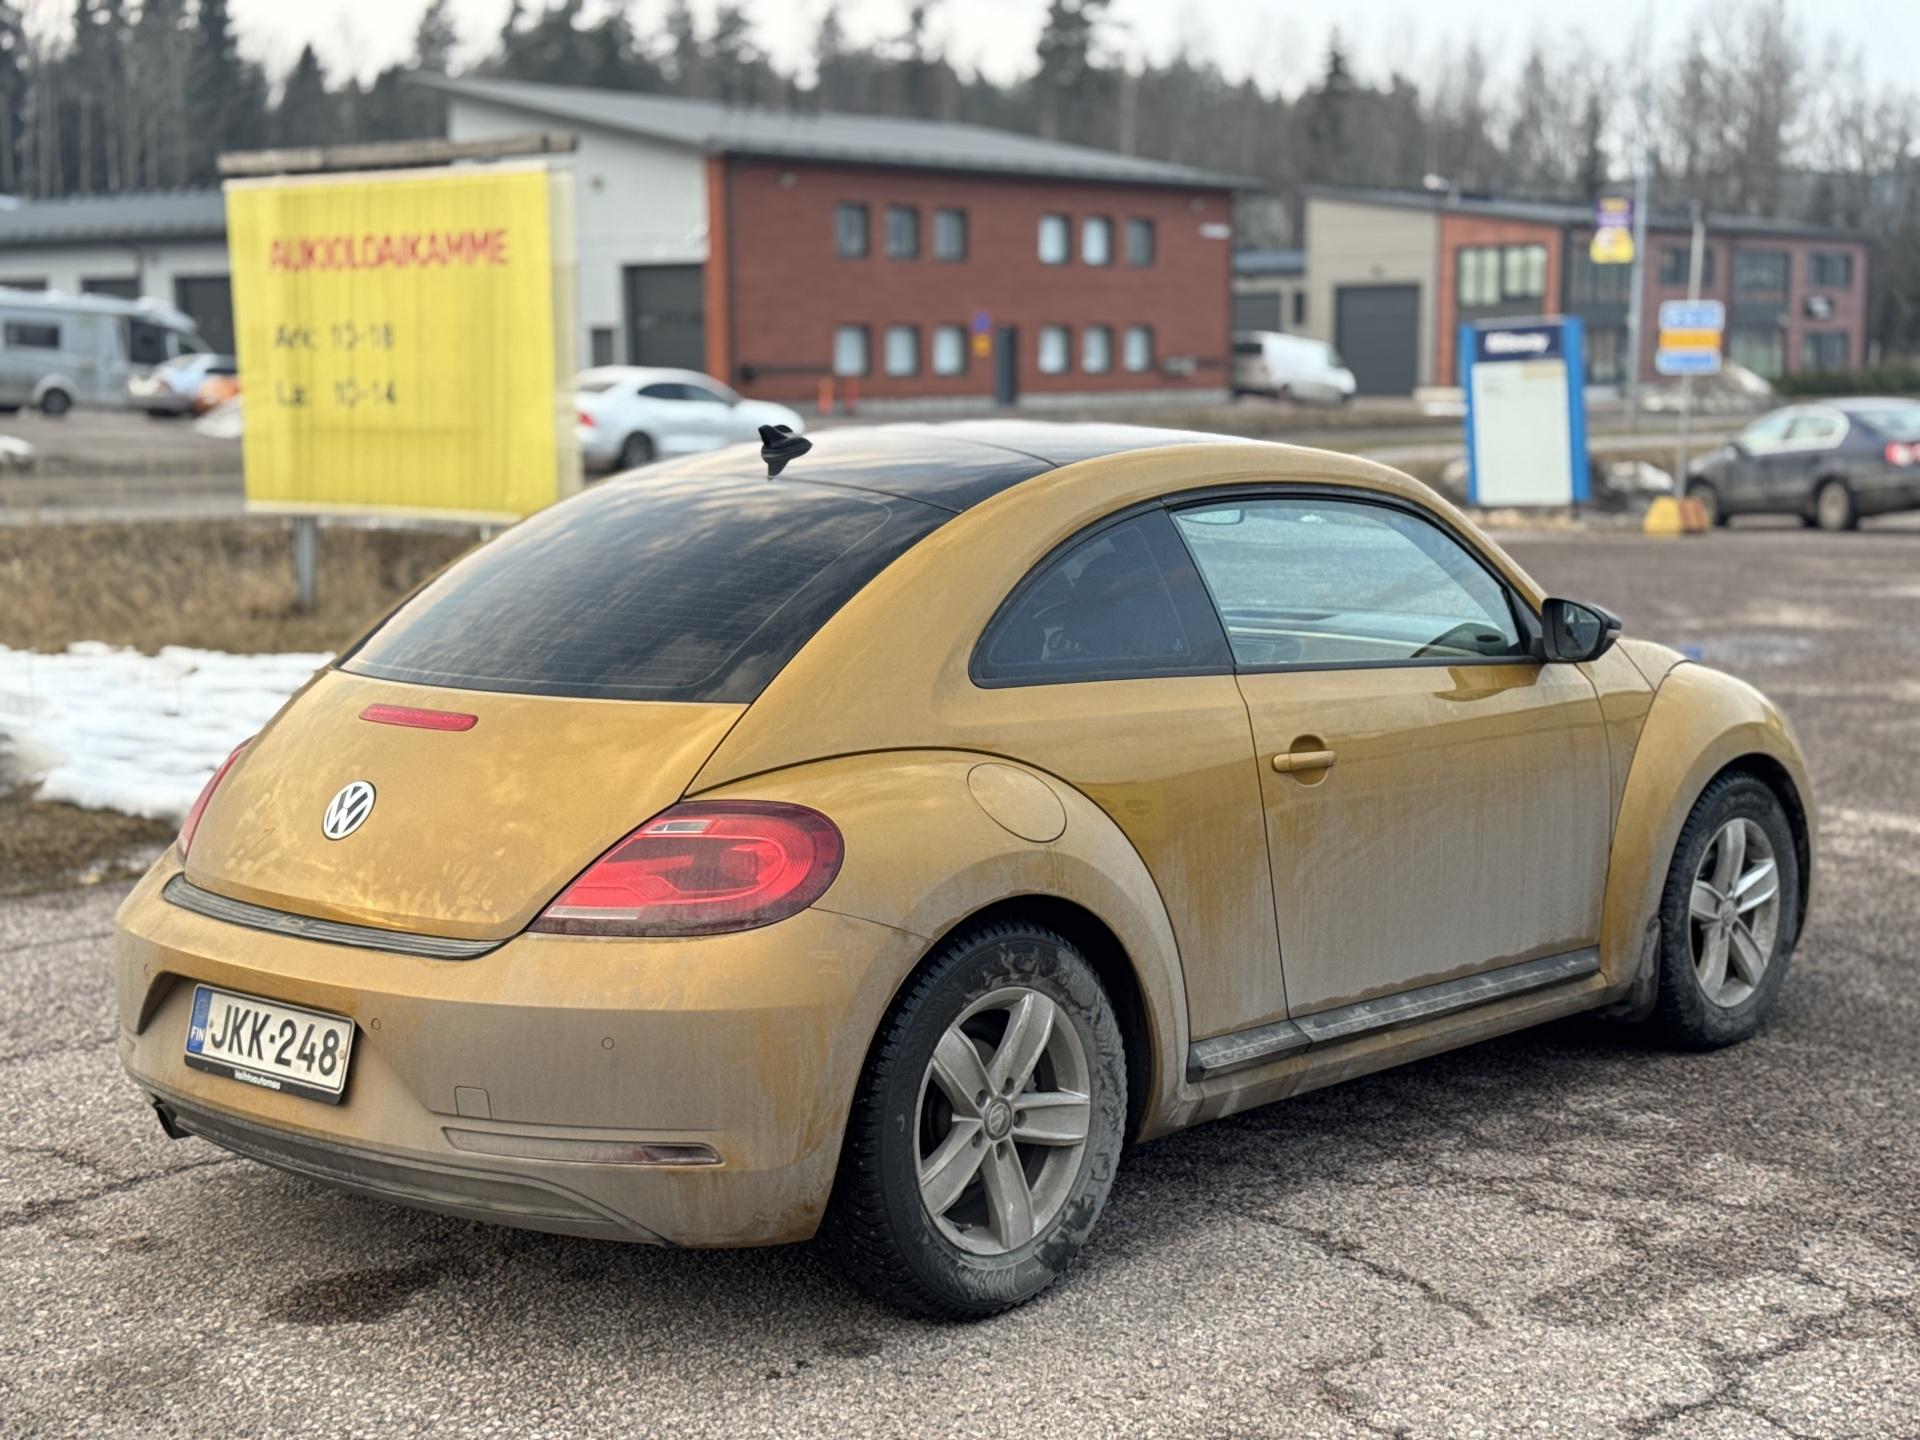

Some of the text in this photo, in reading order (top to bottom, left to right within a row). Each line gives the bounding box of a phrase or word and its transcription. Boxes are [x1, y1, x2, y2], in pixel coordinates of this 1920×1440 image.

[271, 230, 509, 272] AUKIOLOAIKAMME
[190, 1026, 206, 1042] FIN
[211, 1004, 341, 1077] JKK-248
